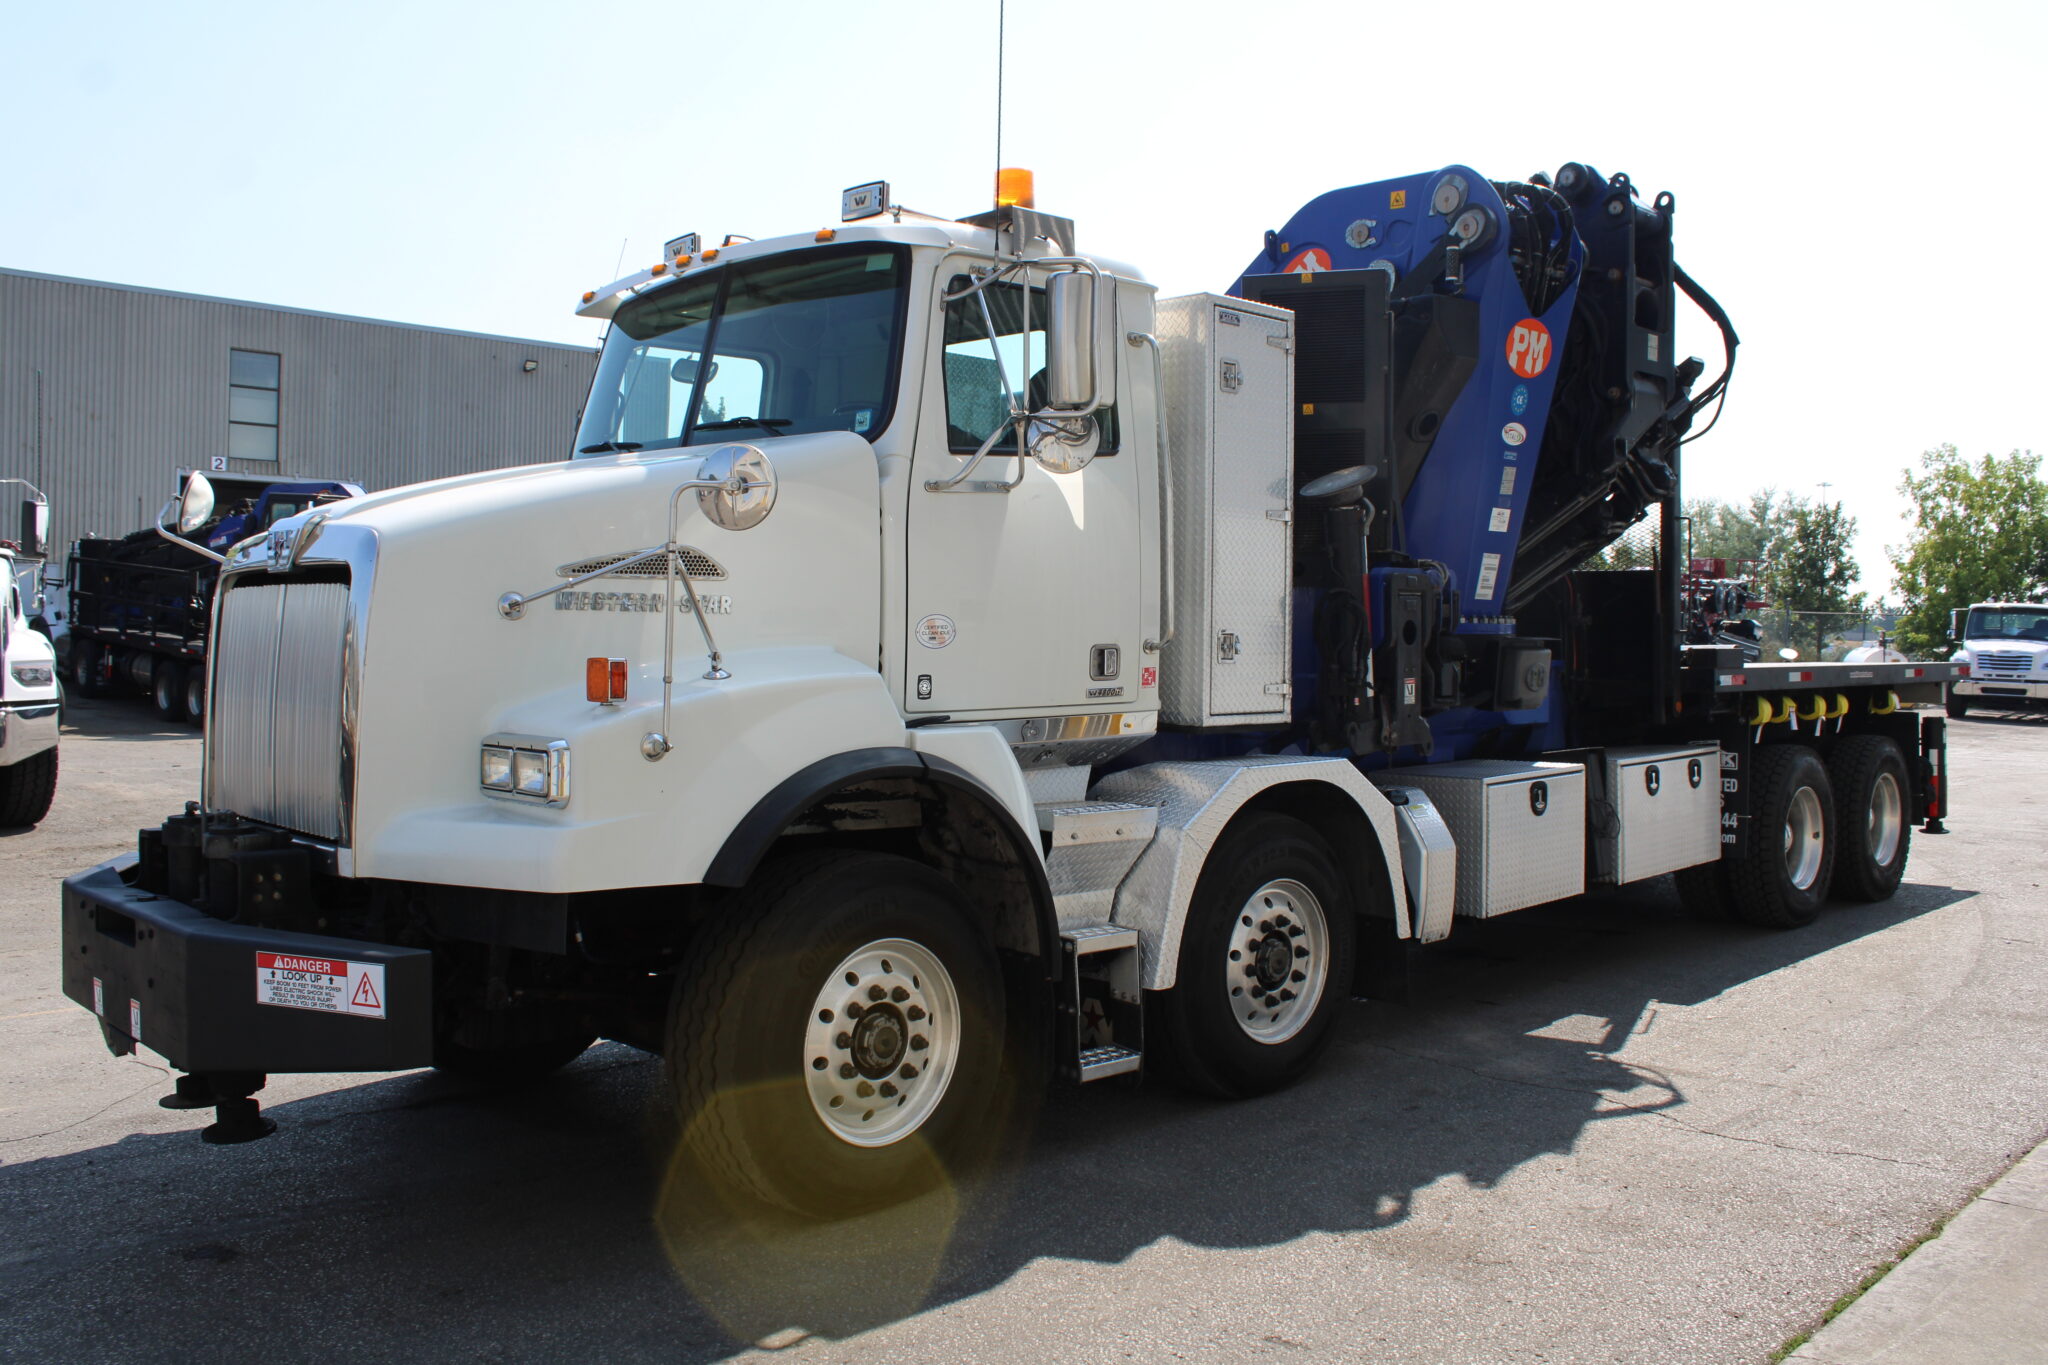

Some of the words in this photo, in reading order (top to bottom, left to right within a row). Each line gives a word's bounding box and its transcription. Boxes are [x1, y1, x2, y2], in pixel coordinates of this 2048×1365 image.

[1508, 325, 1549, 375] PM
[214, 457, 224, 470] 2
[555, 591, 664, 613] WESTERN
[284, 957, 331, 973] DANGER
[282, 971, 307, 982] LOOK
[310, 974, 322, 983] UP
[284, 987, 306, 995] ELECTRIC
